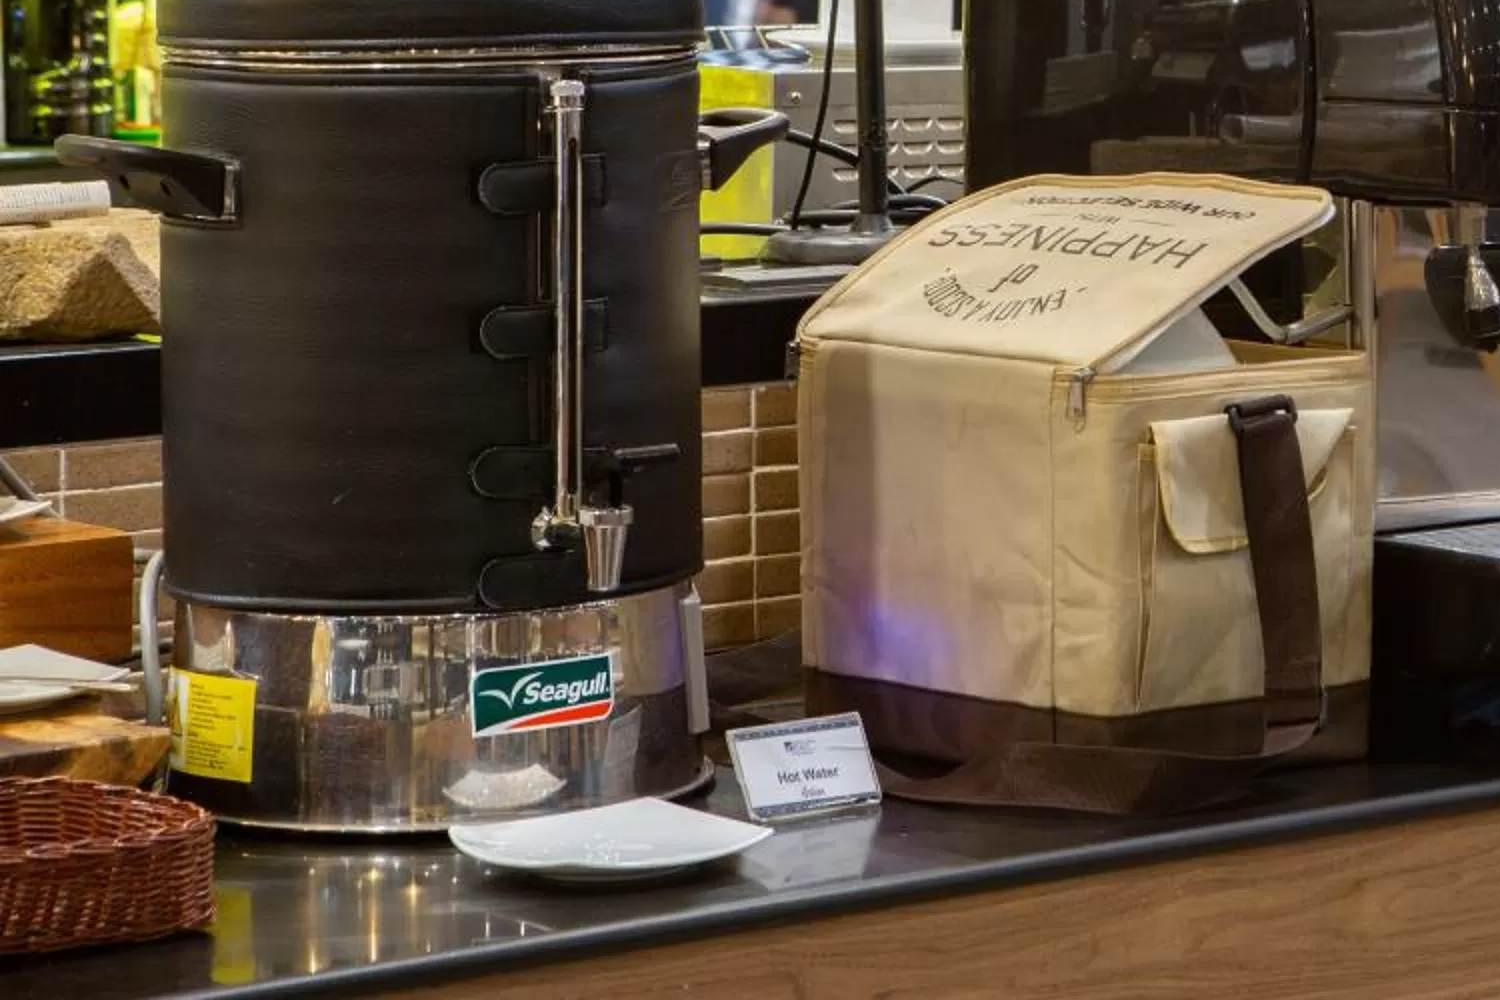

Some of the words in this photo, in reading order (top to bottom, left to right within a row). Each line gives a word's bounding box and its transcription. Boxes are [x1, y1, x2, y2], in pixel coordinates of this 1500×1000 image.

[927, 223, 1207, 270] HAPPINESS
[986, 262, 1040, 294] of
[977, 287, 1067, 323] ENJOY
[522, 670, 607, 705] Seagull
[777, 769, 800, 786] Hot
[801, 766, 839, 782] Water
